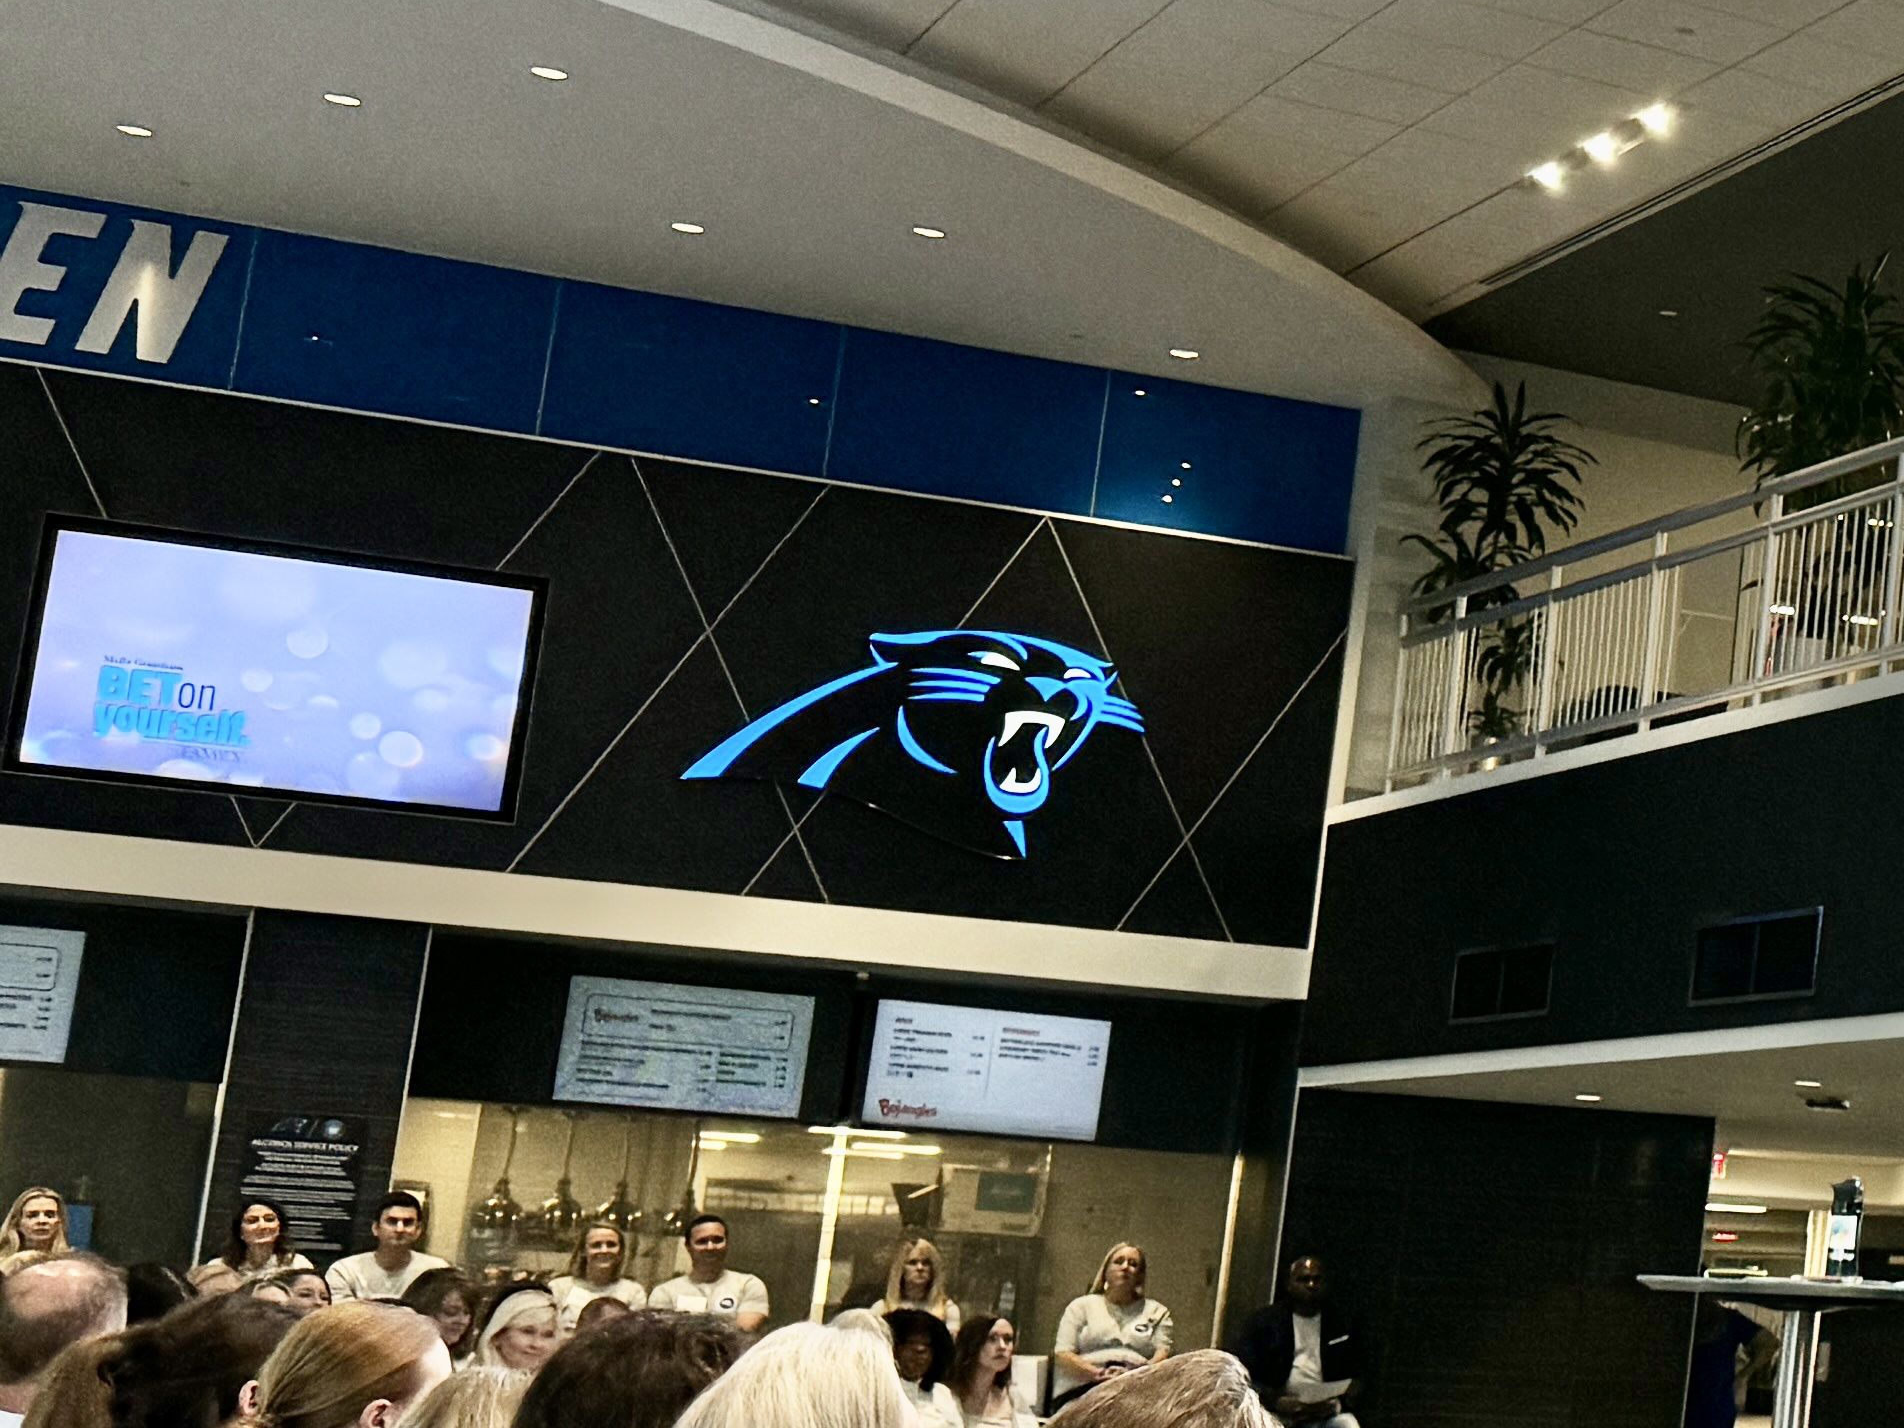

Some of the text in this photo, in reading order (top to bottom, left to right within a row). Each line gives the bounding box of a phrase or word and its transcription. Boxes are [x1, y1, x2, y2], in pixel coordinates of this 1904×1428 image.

[97, 664, 216, 711] BET on
[93, 702, 251, 748] yourself.
